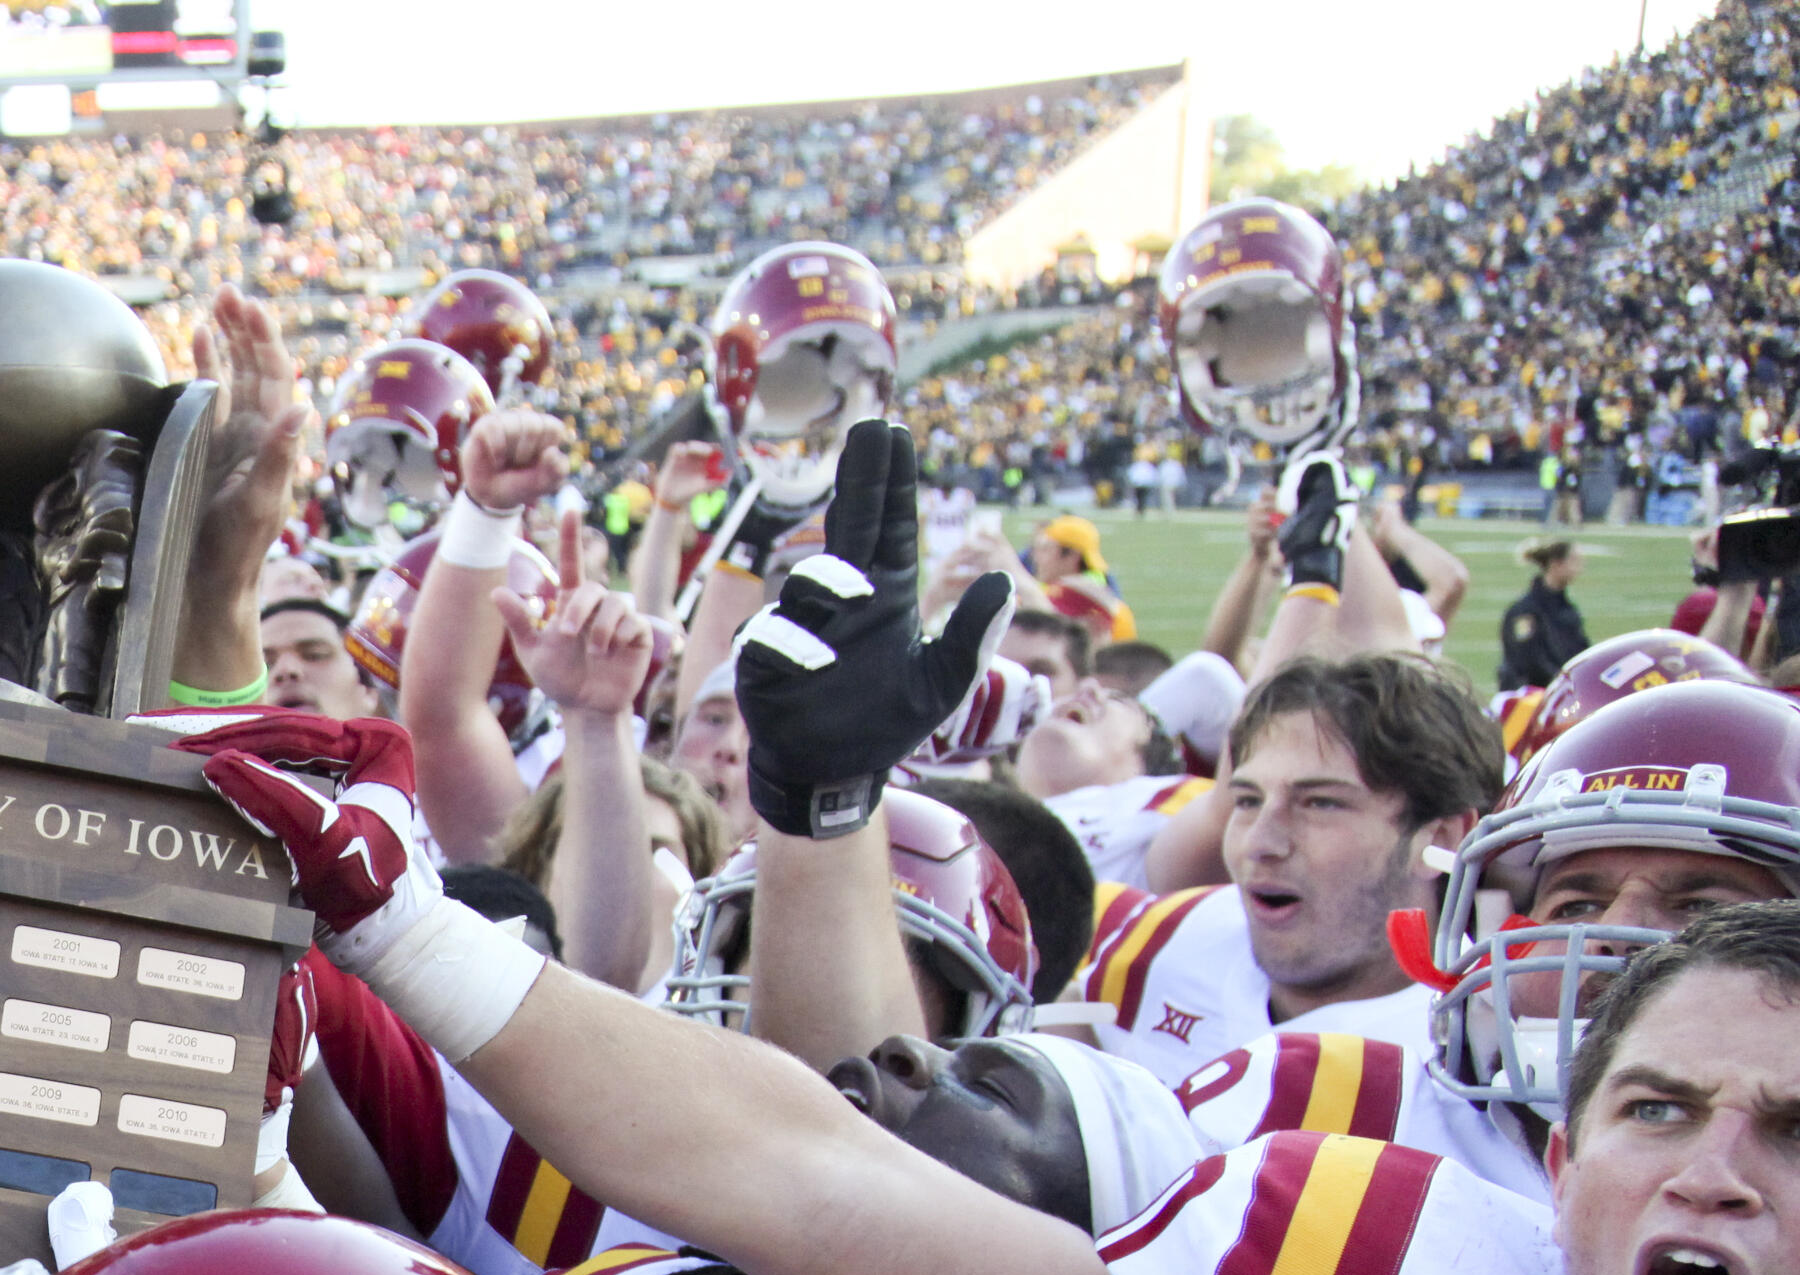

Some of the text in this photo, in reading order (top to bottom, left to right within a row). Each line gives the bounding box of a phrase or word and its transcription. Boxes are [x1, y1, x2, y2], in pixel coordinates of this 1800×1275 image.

[1586, 773, 1680, 793] ALL IN
[34, 803, 107, 846] OF
[123, 818, 270, 880] IOWA
[53, 939, 81, 954] 2001
[20, 949, 40, 959] IOWA
[42, 953, 66, 963] STATE
[78, 959, 98, 969] IOWA
[177, 959, 208, 977] 2002
[145, 971, 164, 980] IOWA
[167, 975, 190, 985] STATE
[205, 981, 224, 991] IOWA
[42, 1011, 72, 1028] 2005
[1152, 1002, 1204, 1044] XII
[10, 1023, 30, 1032] IOWA
[32, 1026, 56, 1037] STATE
[71, 1033, 90, 1042] IOWA
[168, 1032, 198, 1049] 2006
[136, 1044, 156, 1054] IOWA
[169, 1050, 188, 1059] IOWA
[191, 1054, 214, 1064] STATE
[31, 1085, 63, 1102] 2009
[0, 1097, 20, 1107] IOWA
[34, 1103, 54, 1113] IOWA
[57, 1107, 80, 1117] STATE
[158, 1107, 189, 1123] 2010
[125, 1120, 144, 1129] IOWA
[161, 1126, 180, 1135] IOWA
[183, 1129, 208, 1140] STATE
